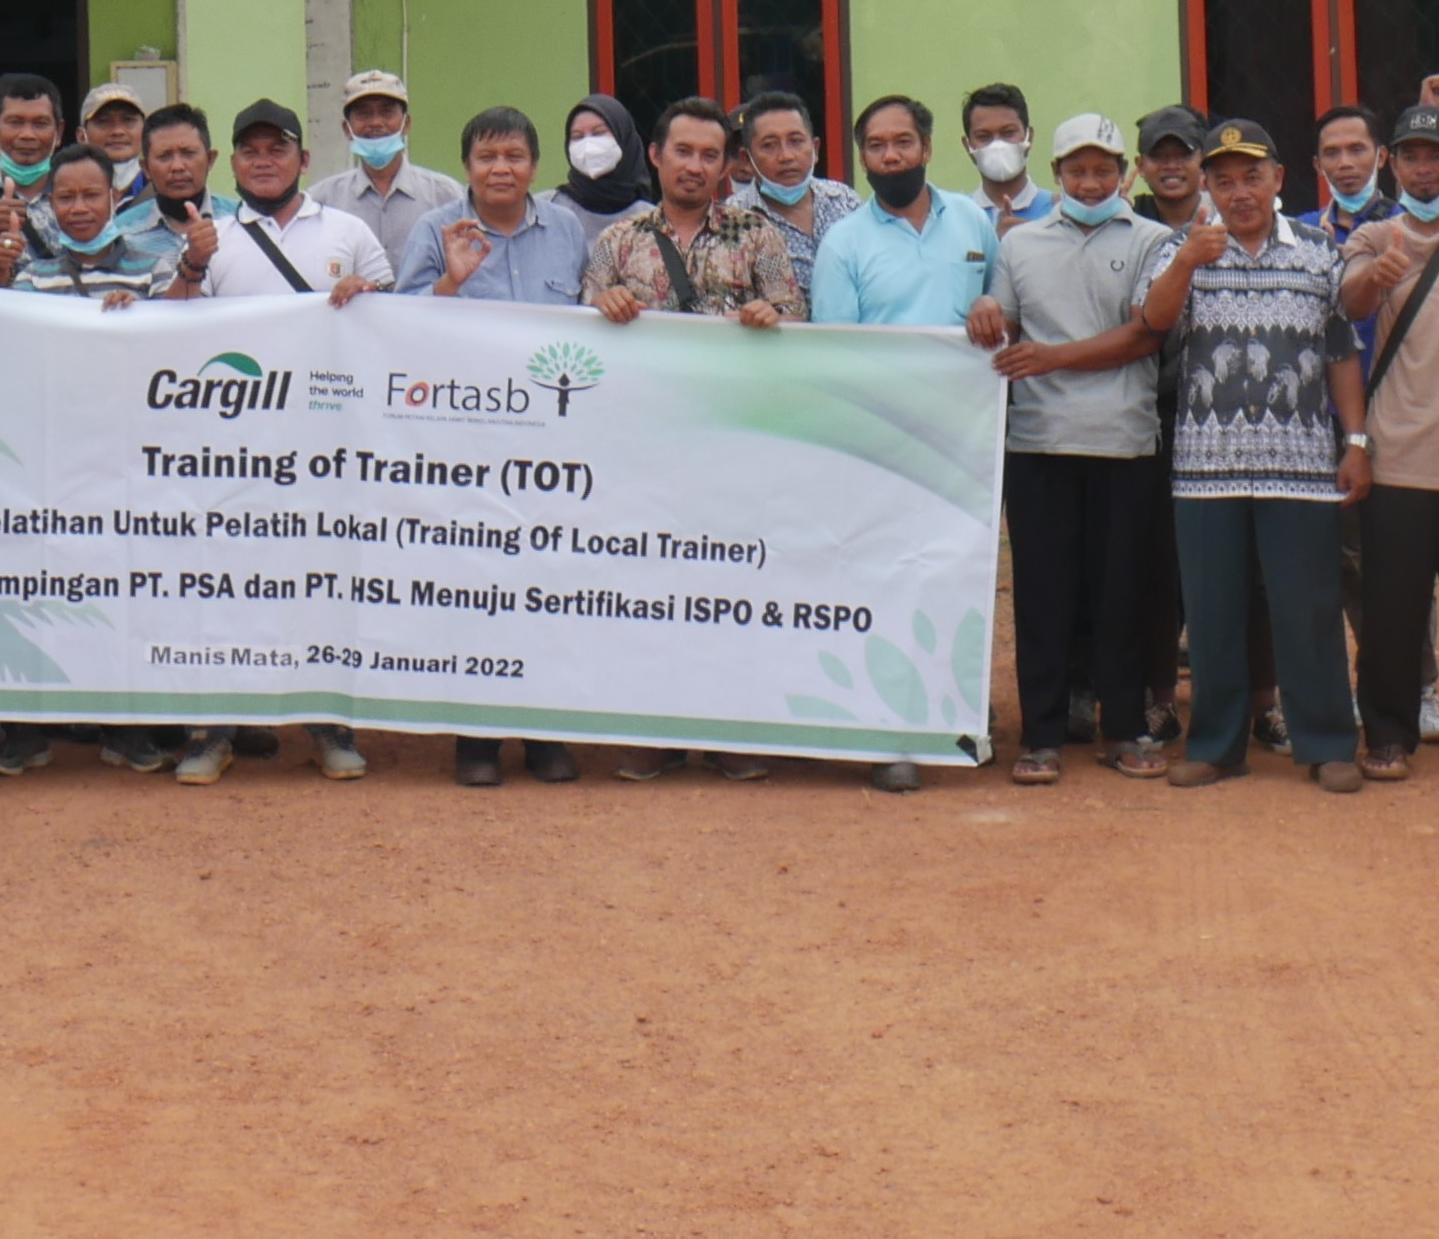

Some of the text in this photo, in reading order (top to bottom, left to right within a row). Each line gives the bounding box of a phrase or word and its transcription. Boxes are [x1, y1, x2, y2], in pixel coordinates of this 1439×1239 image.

[146, 368, 291, 419] Cargill
[309, 370, 354, 385] Helping
[309, 385, 364, 398] the world
[387, 372, 530, 414] Fortasb
[308, 400, 342, 411] thrive
[142, 445, 593, 500] Training of Trainer (TOT)
[113, 508, 197, 538] Untuk
[205, 509, 307, 539] Pelatih
[317, 512, 388, 543] Lokal
[395, 516, 521, 554] (Training
[529, 524, 563, 552] Of
[571, 527, 647, 559] Local
[657, 532, 767, 570] Trainer)
[129, 572, 169, 598] PT.
[178, 572, 235, 599] PSA
[244, 573, 296, 600] dan
[305, 572, 343, 600] PT.
[351, 576, 401, 605] HSL
[410, 580, 516, 616] Menuju
[524, 586, 675, 622] Sertifikasi
[684, 596, 752, 626] ISPO
[761, 601, 784, 628] &
[793, 603, 873, 633] RSPO
[151, 644, 524, 679] Manis Mata, 26-29 Januari 2022
